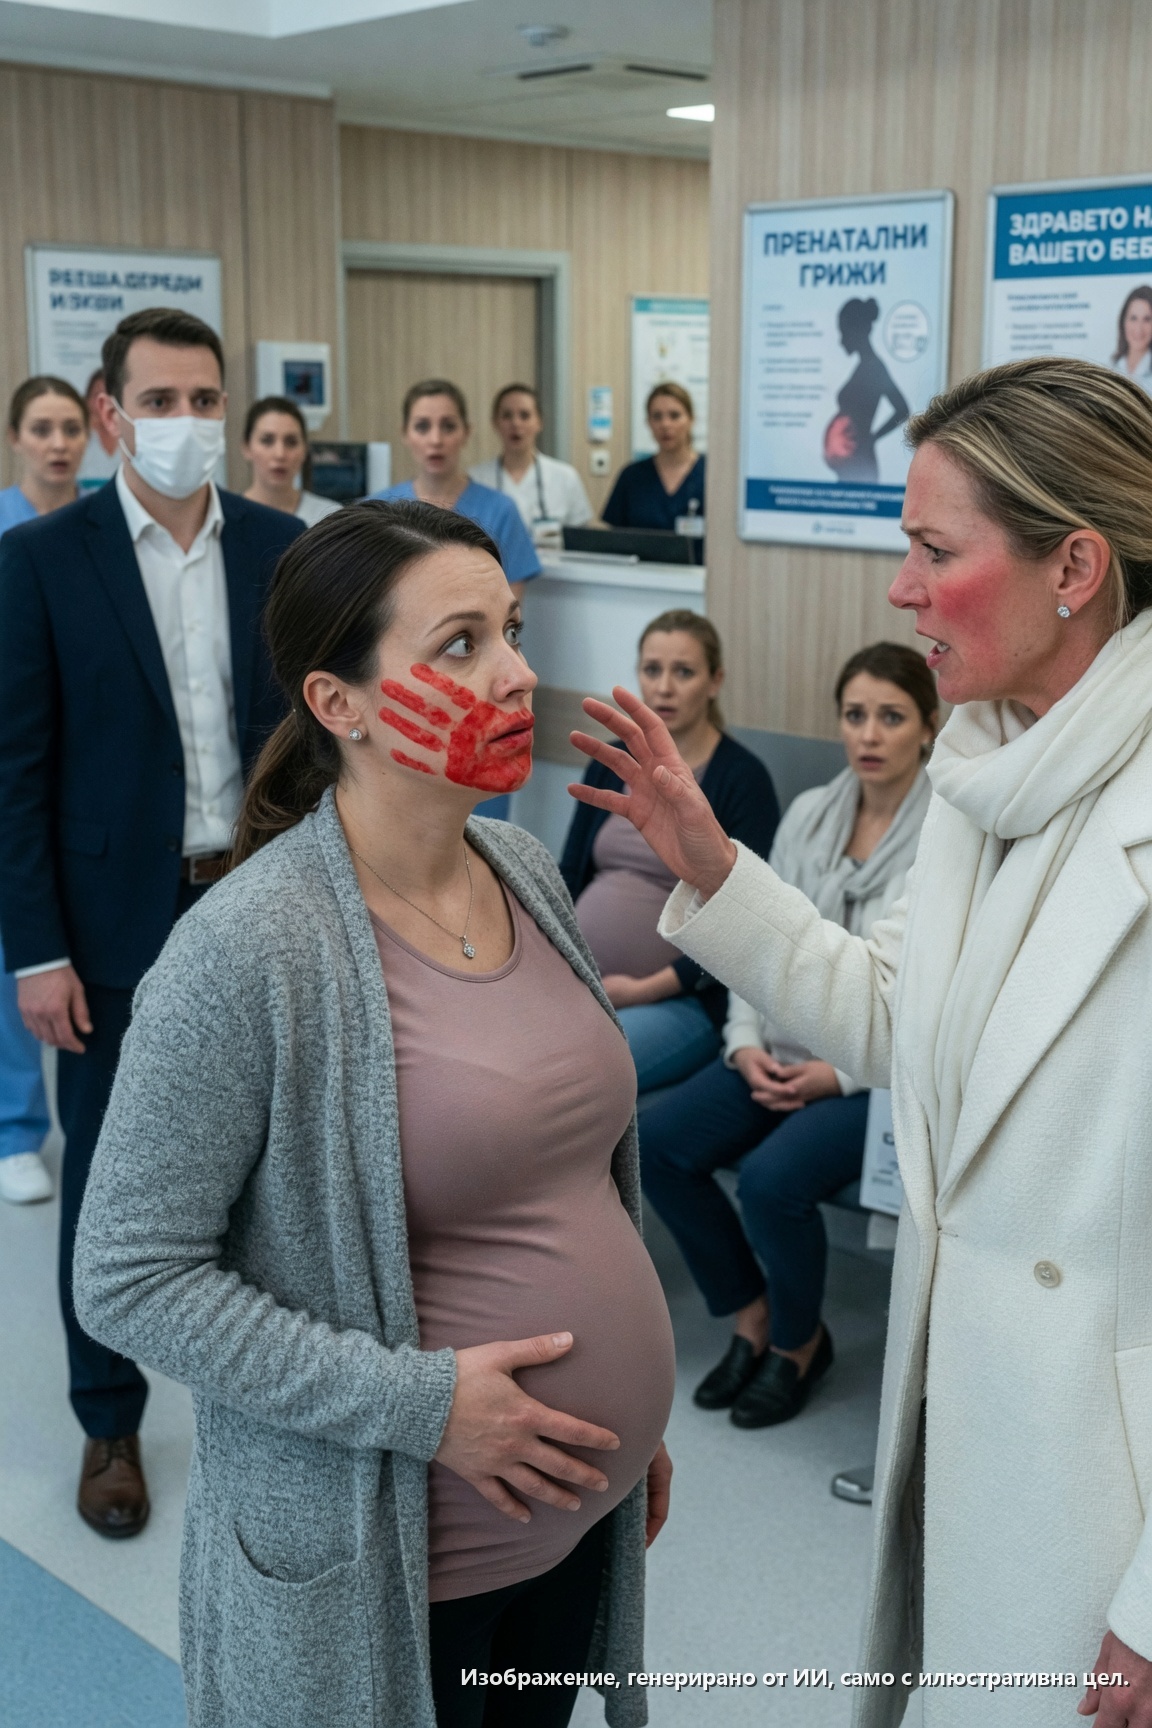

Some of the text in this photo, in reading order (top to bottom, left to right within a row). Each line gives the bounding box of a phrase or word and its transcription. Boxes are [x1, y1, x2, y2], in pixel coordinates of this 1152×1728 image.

[1009, 205, 1152, 239] ЗДРАВЕТО Н
[763, 223, 928, 256] ПРЕНАТАЛНИ
[1008, 238, 1105, 266] ВАШЕТО
[799, 261, 886, 288] ГРИЖИ
